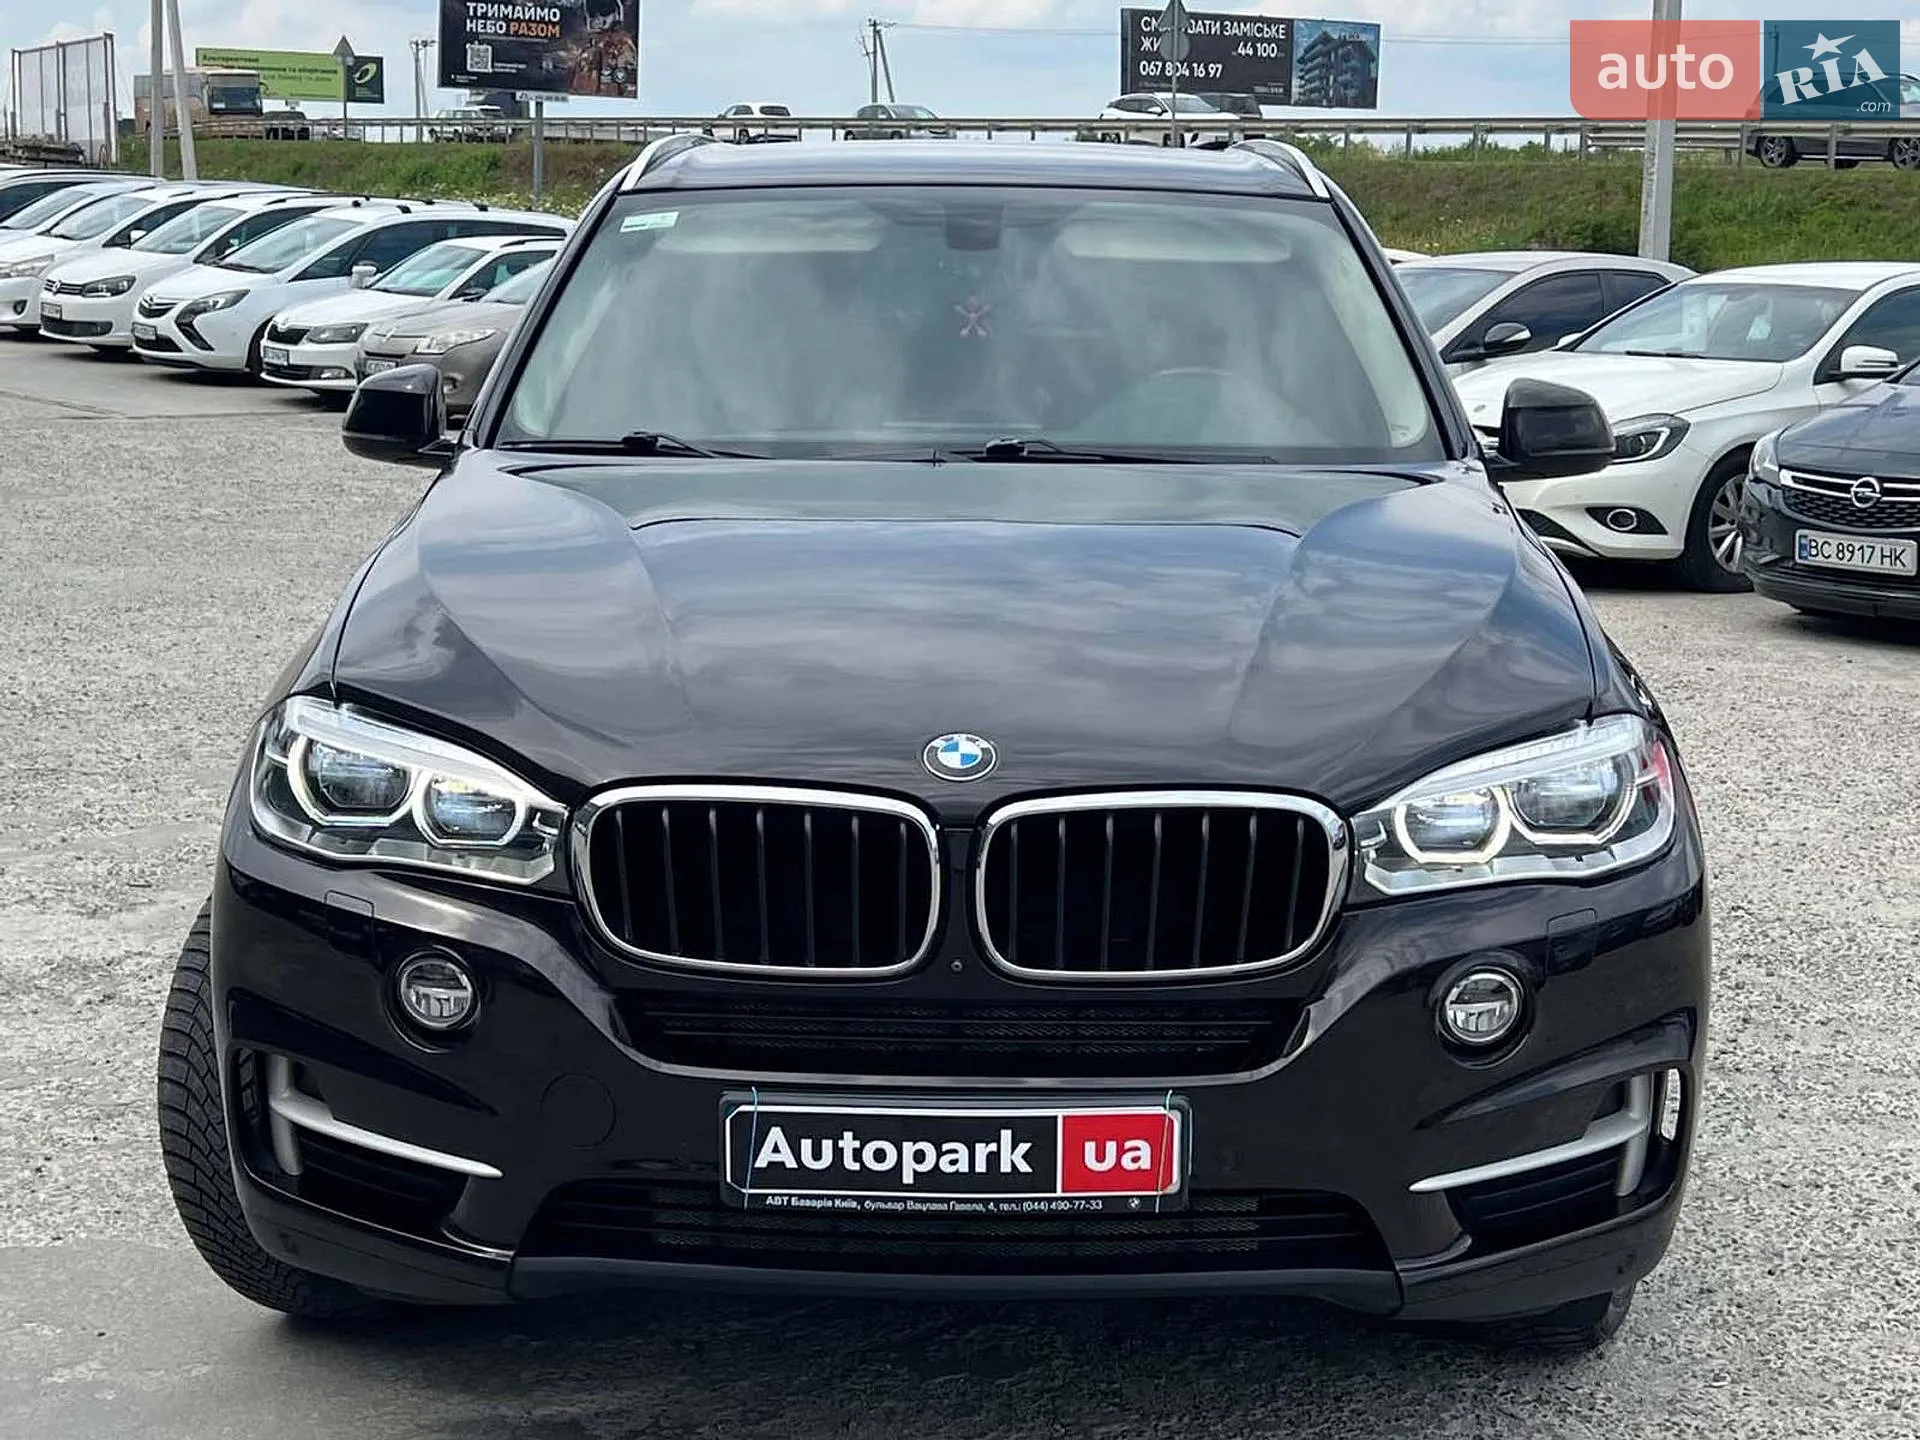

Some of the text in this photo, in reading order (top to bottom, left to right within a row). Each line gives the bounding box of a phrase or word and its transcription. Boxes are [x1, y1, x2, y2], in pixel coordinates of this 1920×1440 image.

[466, 2, 561, 22] ТРИМАЙМО
[466, 19, 560, 38] НЕБО РАЗОМ
[1223, 22, 1287, 39] ЗАМІСЬКЕ
[1237, 41, 1254, 56] 44
[1256, 43, 1278, 58] 100
[1139, 61, 1223, 78] 067 804 16 97
[1808, 539, 1906, 568] BC 8917 HK
[755, 1126, 1152, 1184] Autopark ua
